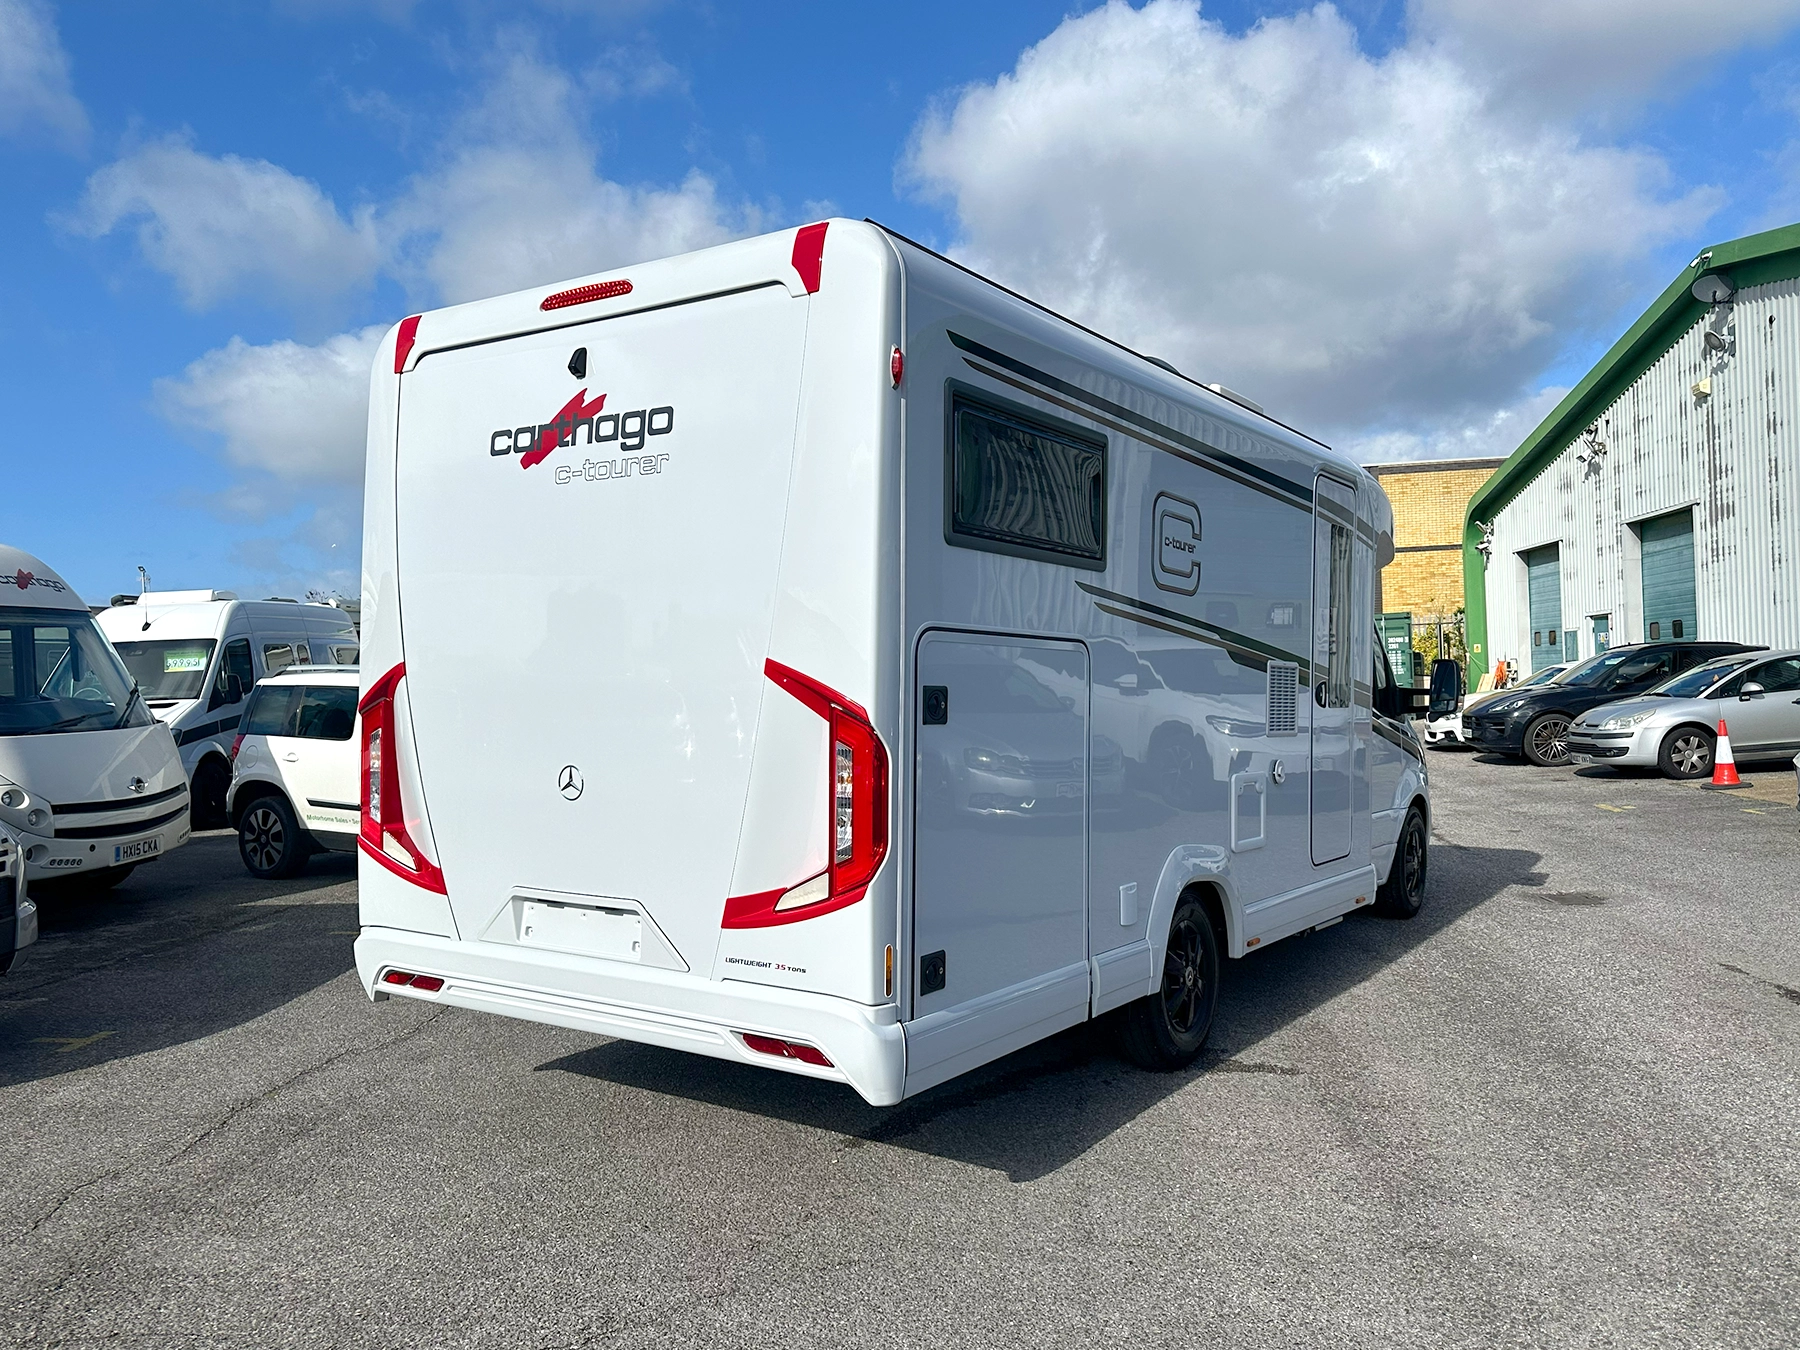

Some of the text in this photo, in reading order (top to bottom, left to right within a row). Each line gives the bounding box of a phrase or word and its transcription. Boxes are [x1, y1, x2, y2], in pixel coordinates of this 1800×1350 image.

[490, 406, 674, 456] carthago
[555, 453, 670, 484] c-tourer
[1164, 536, 1197, 554] c-tourer
[0, 575, 66, 592] cahago
[306, 814, 334, 822] Motorhome
[122, 839, 159, 859] HX15 CKA
[725, 957, 772, 969] LIGHTWEIGHT
